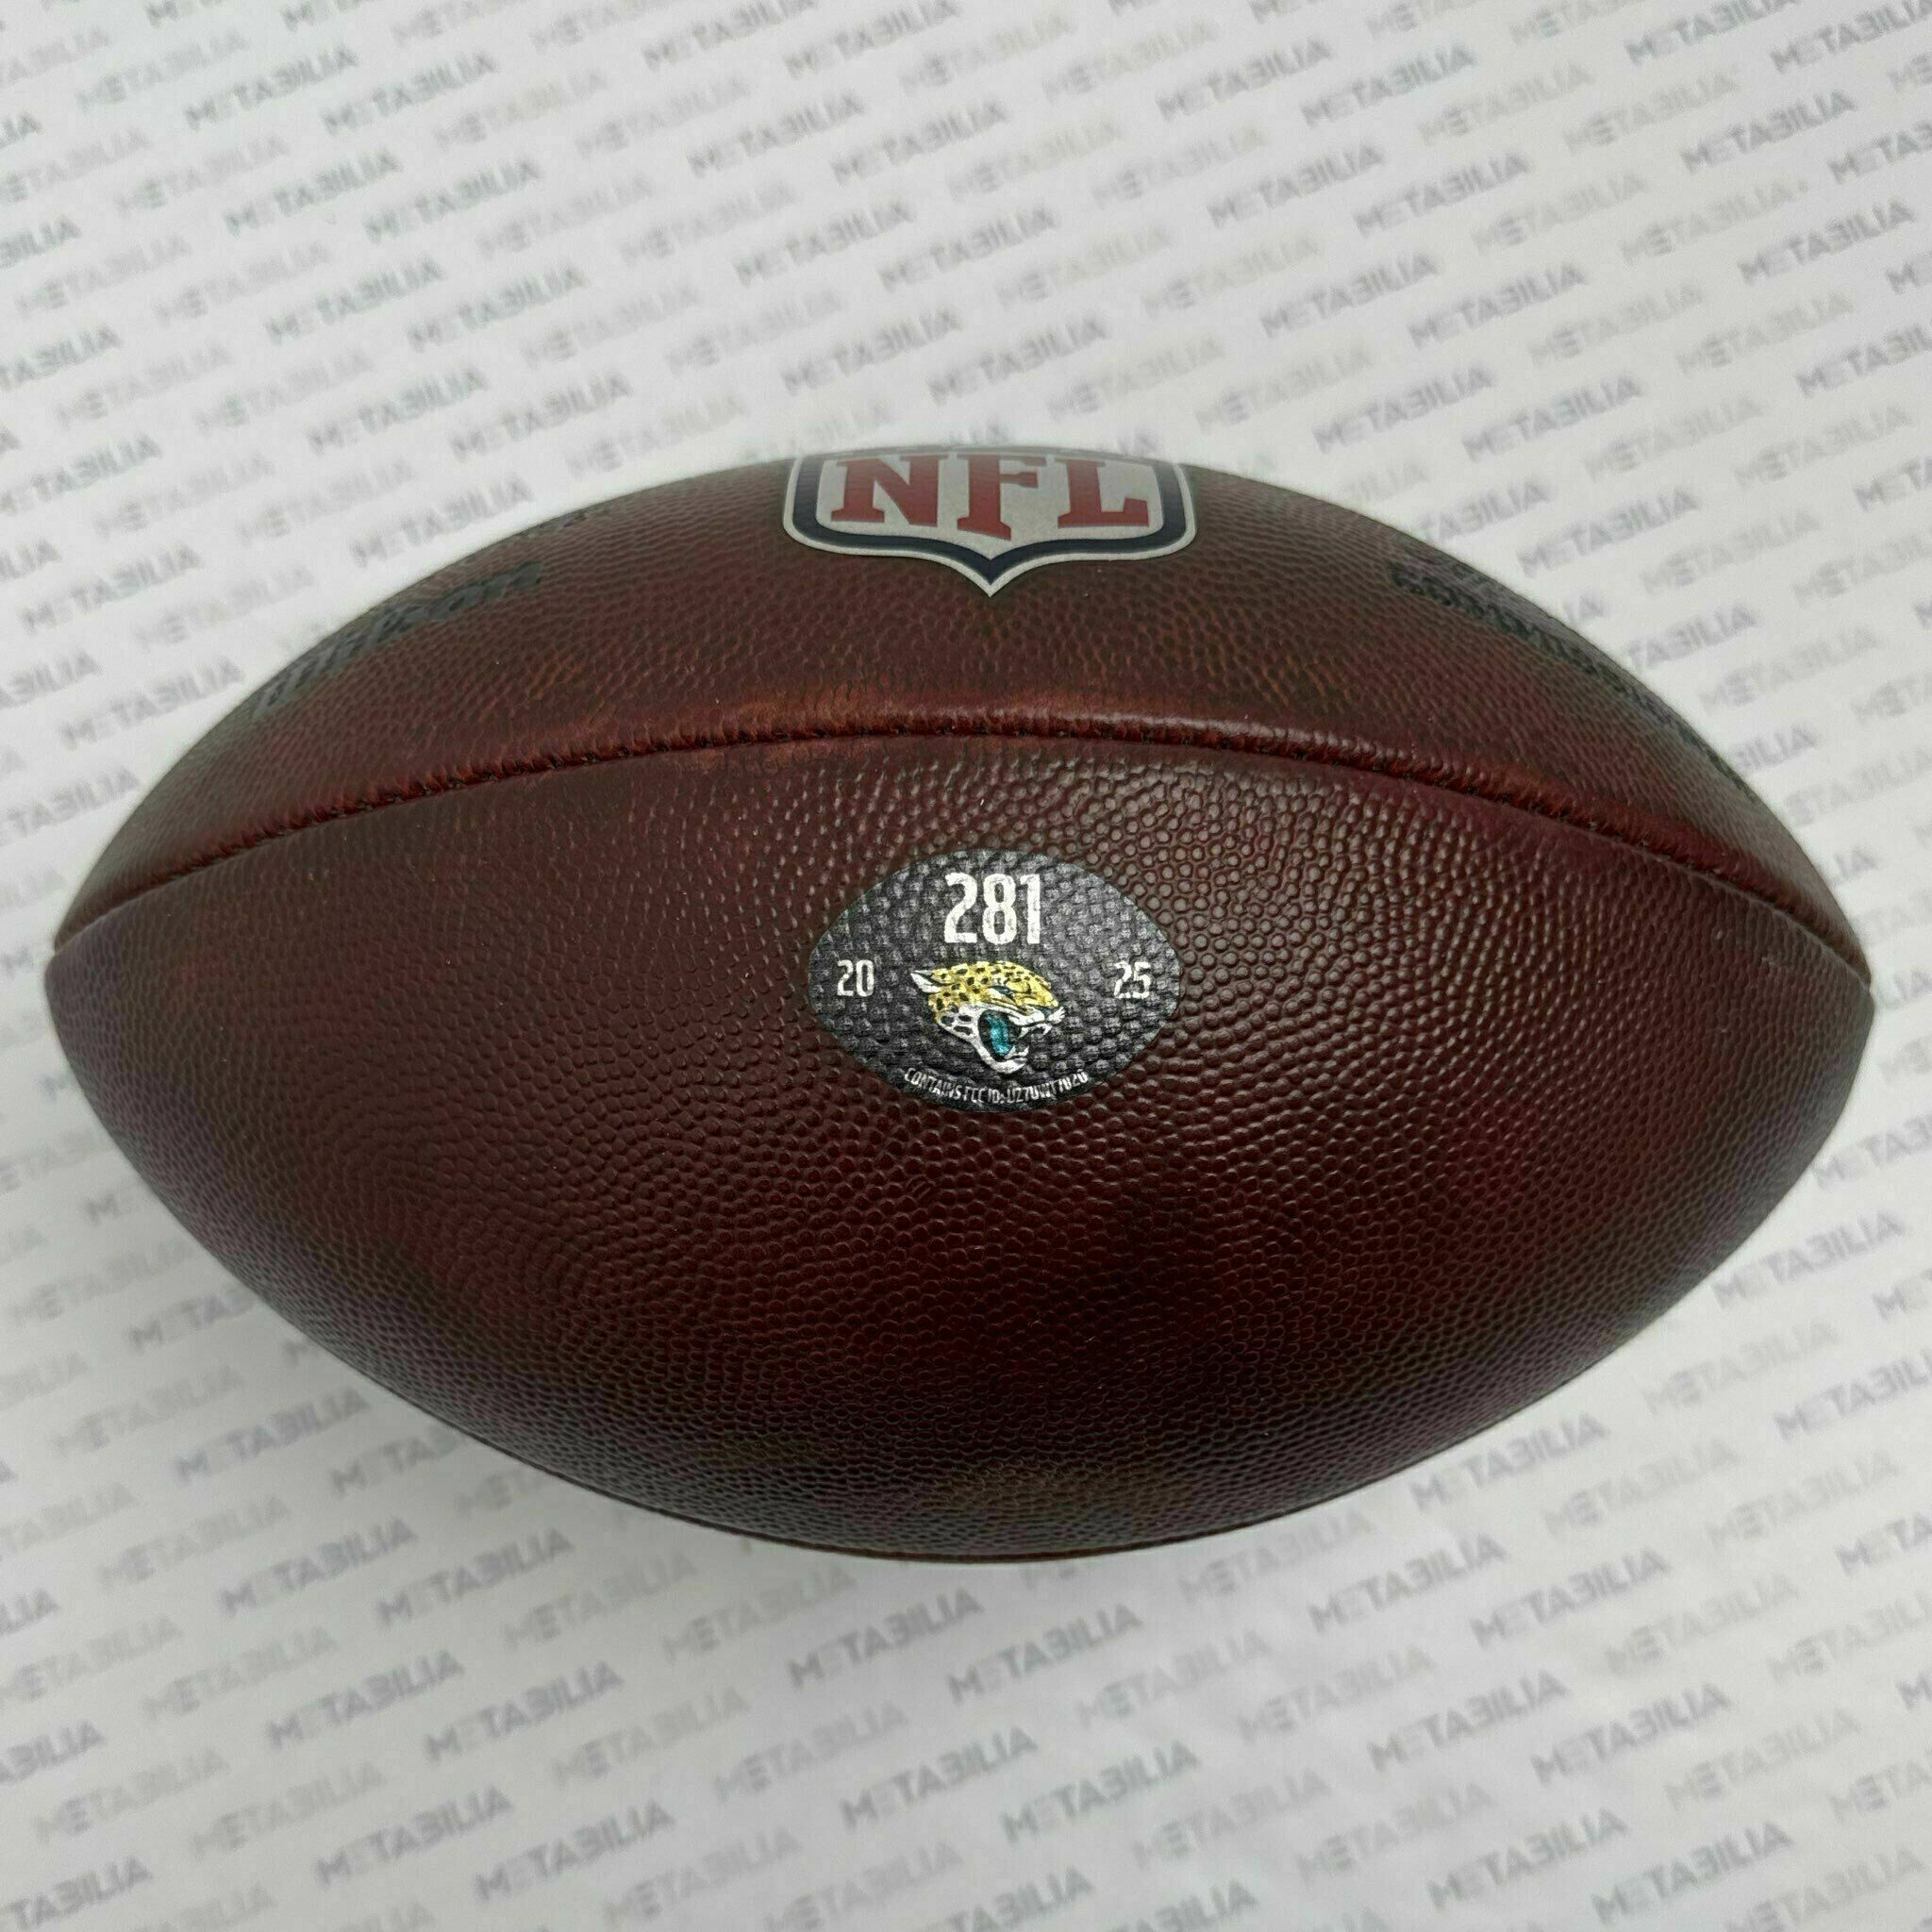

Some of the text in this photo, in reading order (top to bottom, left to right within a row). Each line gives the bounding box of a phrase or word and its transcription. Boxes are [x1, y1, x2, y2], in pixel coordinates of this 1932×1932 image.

[831, 454, 1150, 541] NFL
[944, 872, 1041, 945] 281
[836, 959, 875, 997] 20
[1113, 960, 1152, 999] 25
[904, 1067, 961, 1101] CONTAINS
